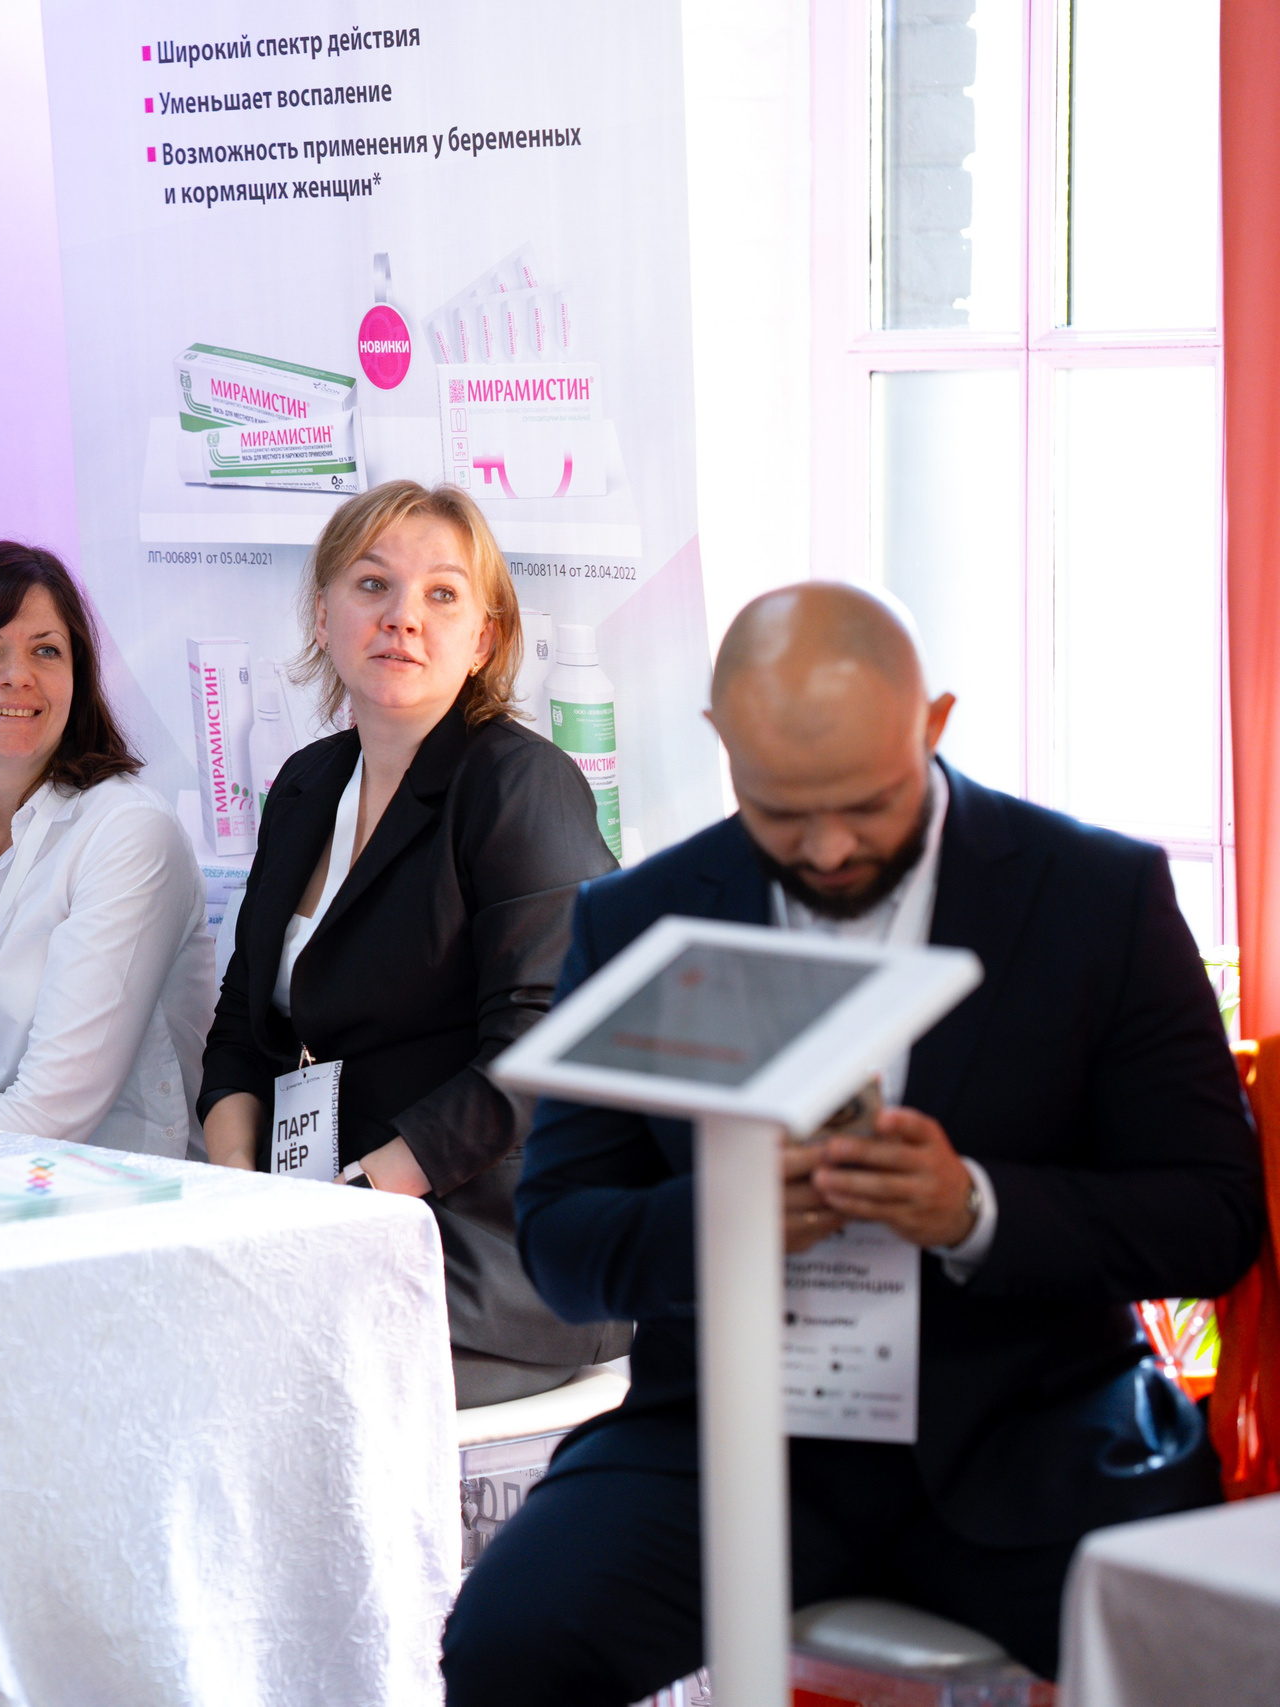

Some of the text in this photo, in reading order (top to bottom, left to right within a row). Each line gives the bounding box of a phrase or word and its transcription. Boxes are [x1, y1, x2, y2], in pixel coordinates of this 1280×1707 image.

[157, 26, 421, 68] Широкий спектр действия
[159, 80, 393, 115] Уменьшает воспаление
[162, 125, 582, 165] Возможность применения у беременных
[164, 186, 176, 204] и
[181, 179, 289, 209] кормящих
[359, 339, 410, 355] НОВИНКИ
[210, 377, 308, 420] МИРАМИСТИН
[467, 378, 590, 402] МИРАМИСТИН
[240, 425, 332, 448] МИРАМИСТИН
[147, 550, 273, 565] ЛП-006891 от 05.04.2021
[510, 562, 637, 581] ЛП-008114 от 28.04.2022
[204, 667, 228, 813] МИРАМИСТИН
[573, 756, 616, 773] АМИСТИН
[331, 1062, 342, 1154] КОНФЕРЕНЦИЯ
[277, 1109, 320, 1143] ПАРТ
[277, 1142, 309, 1174] НЁР
